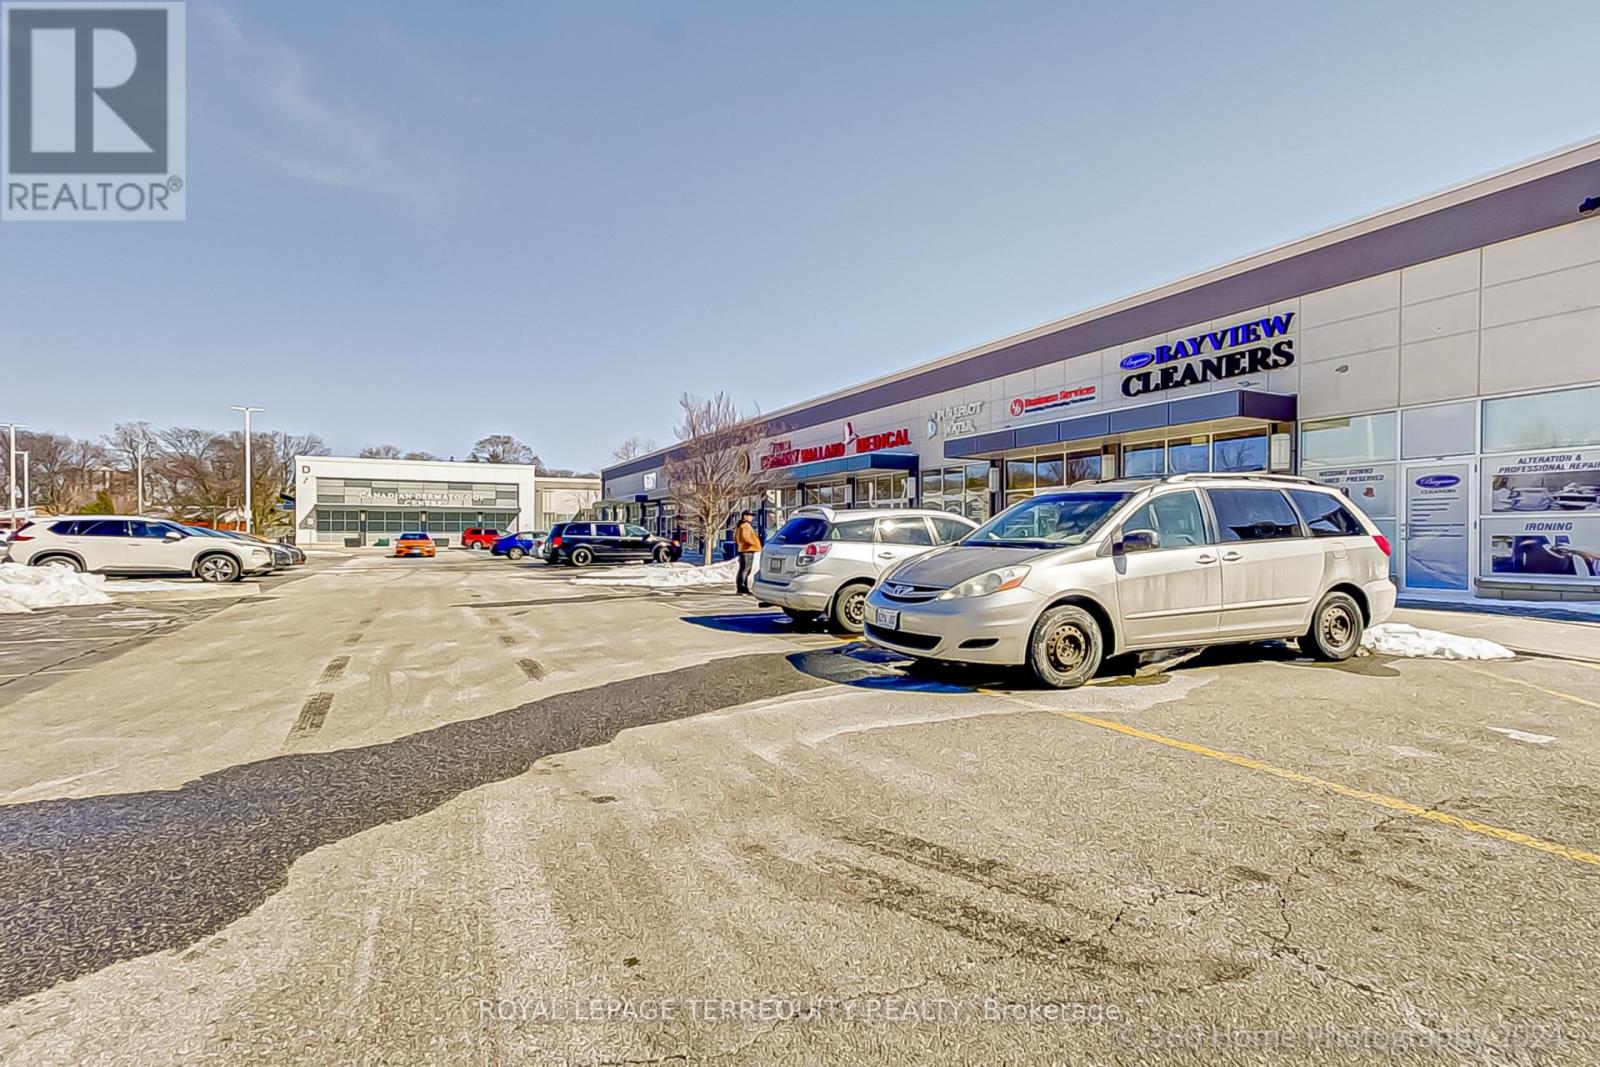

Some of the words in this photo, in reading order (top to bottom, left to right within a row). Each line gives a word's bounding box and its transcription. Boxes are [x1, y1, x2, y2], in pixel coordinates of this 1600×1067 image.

[1154, 312, 1296, 365] BAYVIEW
[1121, 340, 1295, 397] CLEANERS
[856, 428, 912, 454] MEDICAL
[1517, 455, 1572, 465] ALTERATION
[301, 465, 311, 474] D
[1498, 464, 1566, 474] PROFESSIONAL
[360, 492, 413, 500] CANADIAN
[415, 493, 484, 502] DERMATOLOGY
[1525, 522, 1573, 531] IRONING
